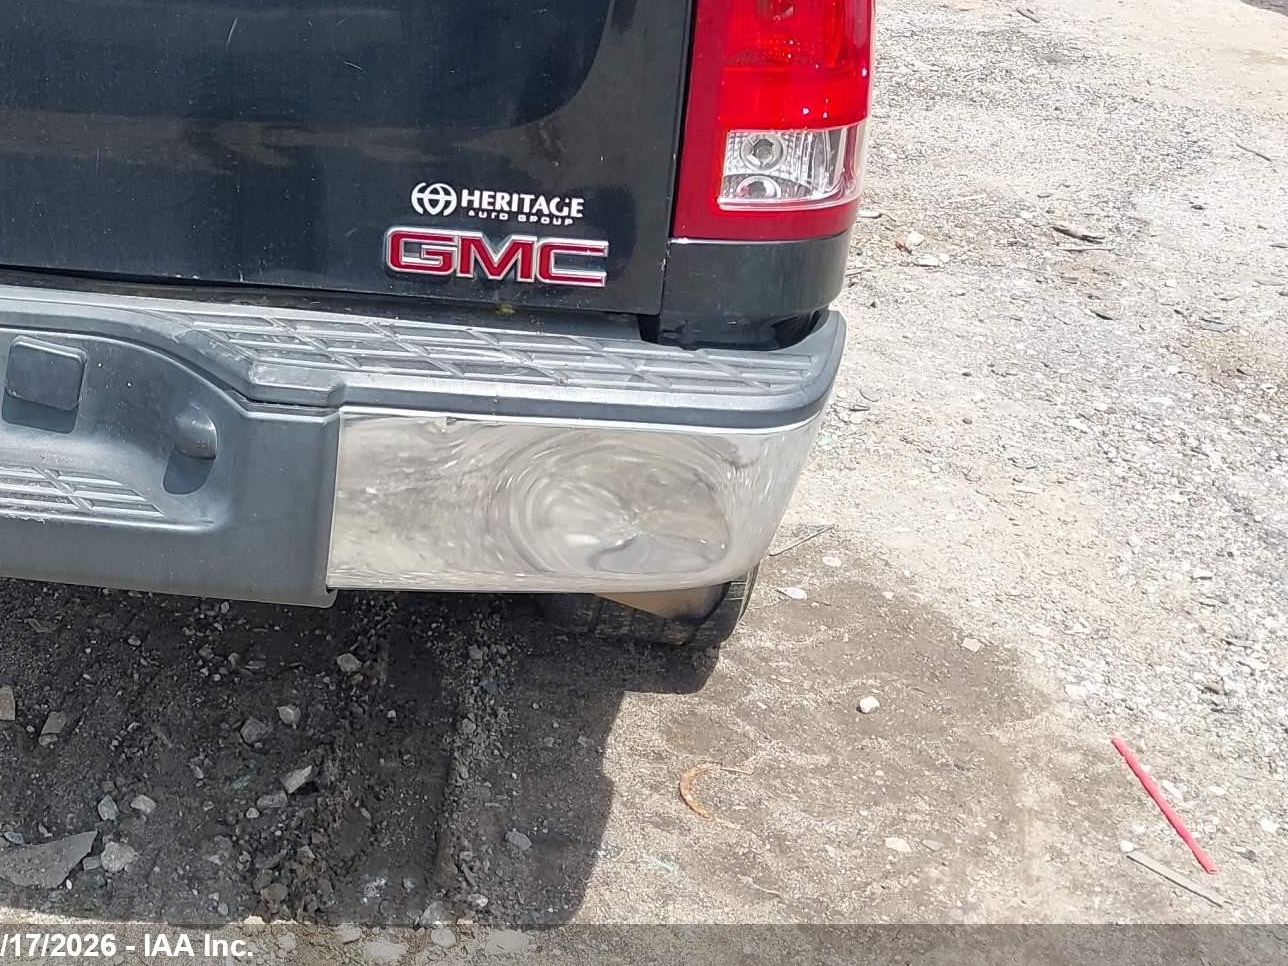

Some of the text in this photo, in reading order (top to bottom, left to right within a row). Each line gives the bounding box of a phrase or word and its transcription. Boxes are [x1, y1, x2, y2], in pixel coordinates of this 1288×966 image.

[461, 189, 585, 218] HERITAGE
[468, 211, 574, 227] AUTO GROUP
[385, 226, 609, 288] GMC
